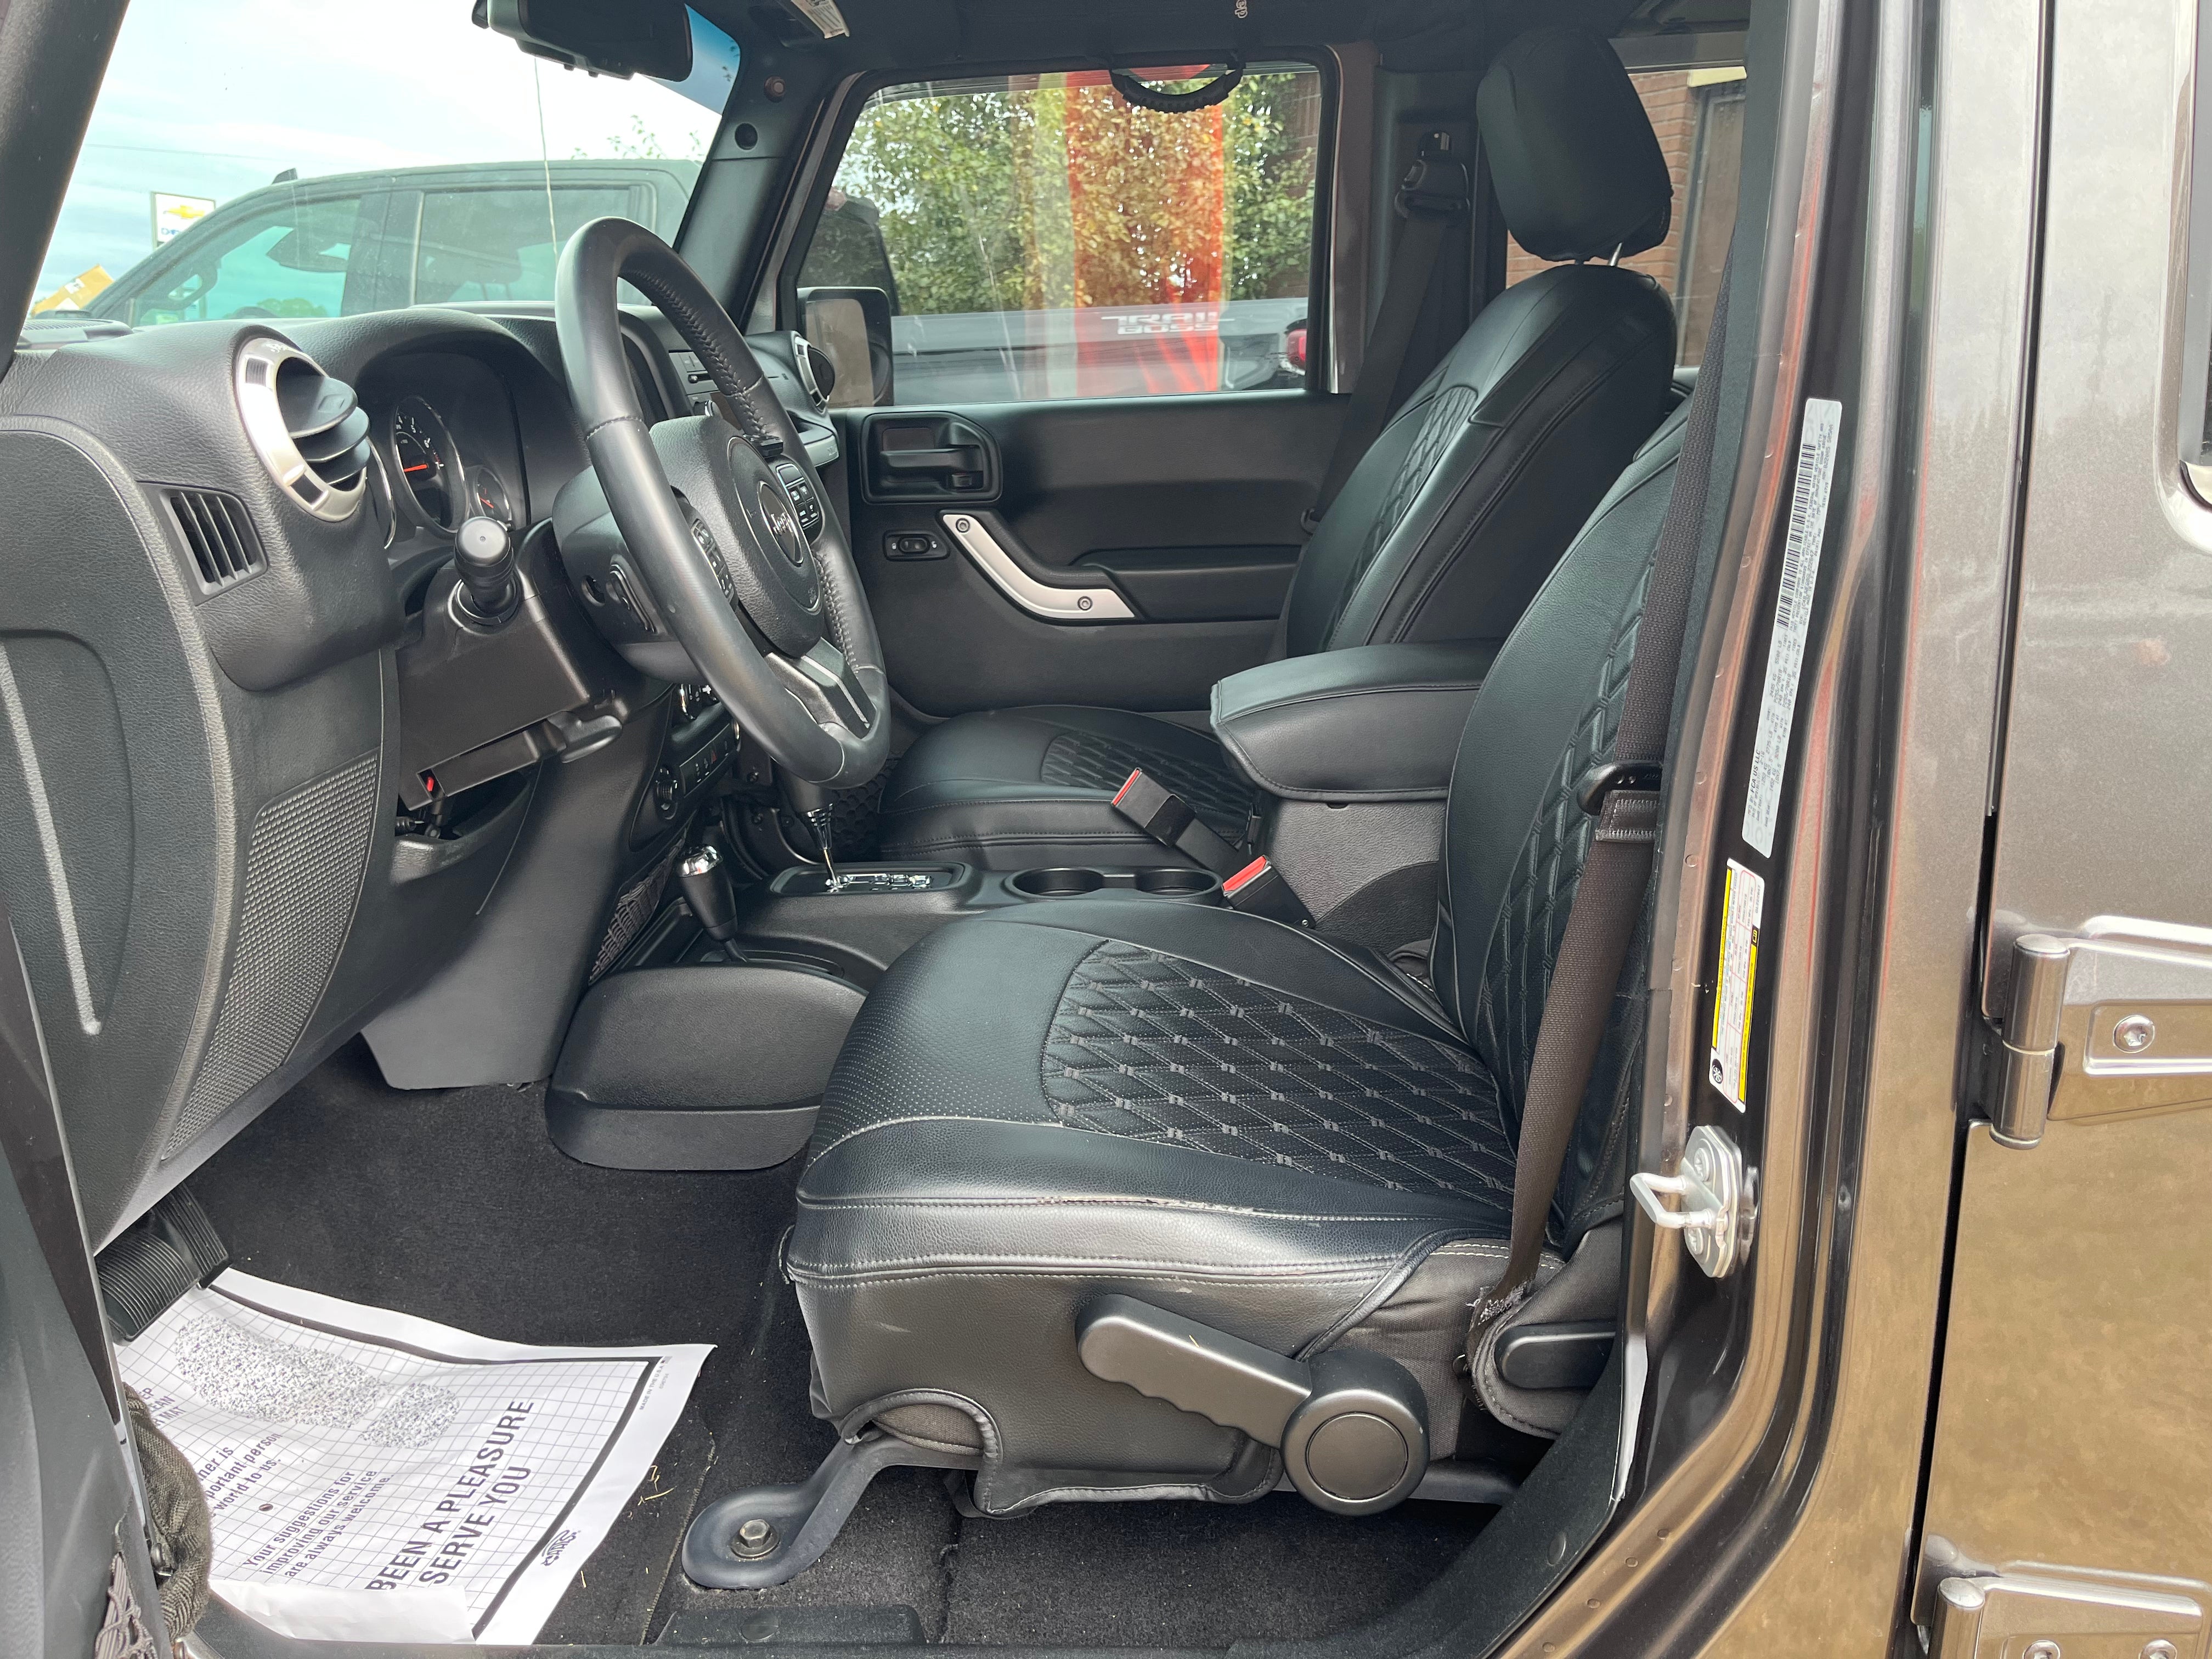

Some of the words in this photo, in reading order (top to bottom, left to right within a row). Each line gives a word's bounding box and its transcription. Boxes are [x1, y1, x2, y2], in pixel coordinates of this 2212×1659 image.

[1118, 324, 1218, 334] BOSS
[1773, 673, 1776, 681] KG
[1769, 730, 1773, 738] LB
[1777, 735, 1781, 743] LB
[1753, 765, 1758, 776] US
[148, 1396, 176, 1412] LEAN
[639, 1395, 650, 1410] MADE
[649, 1379, 657, 1389] THE
[159, 1406, 187, 1420] MAT
[216, 1447, 234, 1459] is
[435, 1401, 534, 1513] PLEASURE
[205, 1461, 247, 1499] portant
[244, 1434, 283, 1464] person
[213, 1483, 249, 1510] world
[244, 1472, 262, 1483] to
[259, 1459, 281, 1471] us.
[244, 1544, 276, 1566] Your
[274, 1488, 340, 1543] suggestions
[334, 1471, 355, 1486] for
[259, 1528, 324, 1575] improving
[318, 1509, 340, 1525] our
[337, 1471, 377, 1507] service
[284, 1562, 308, 1577] are
[304, 1525, 346, 1560] always
[342, 1474, 394, 1522] welcome.
[419, 1513, 495, 1584] SERVE
[478, 1466, 532, 1506] YOU
[421, 1520, 452, 1533] A
[364, 1541, 435, 1590] BEEN
